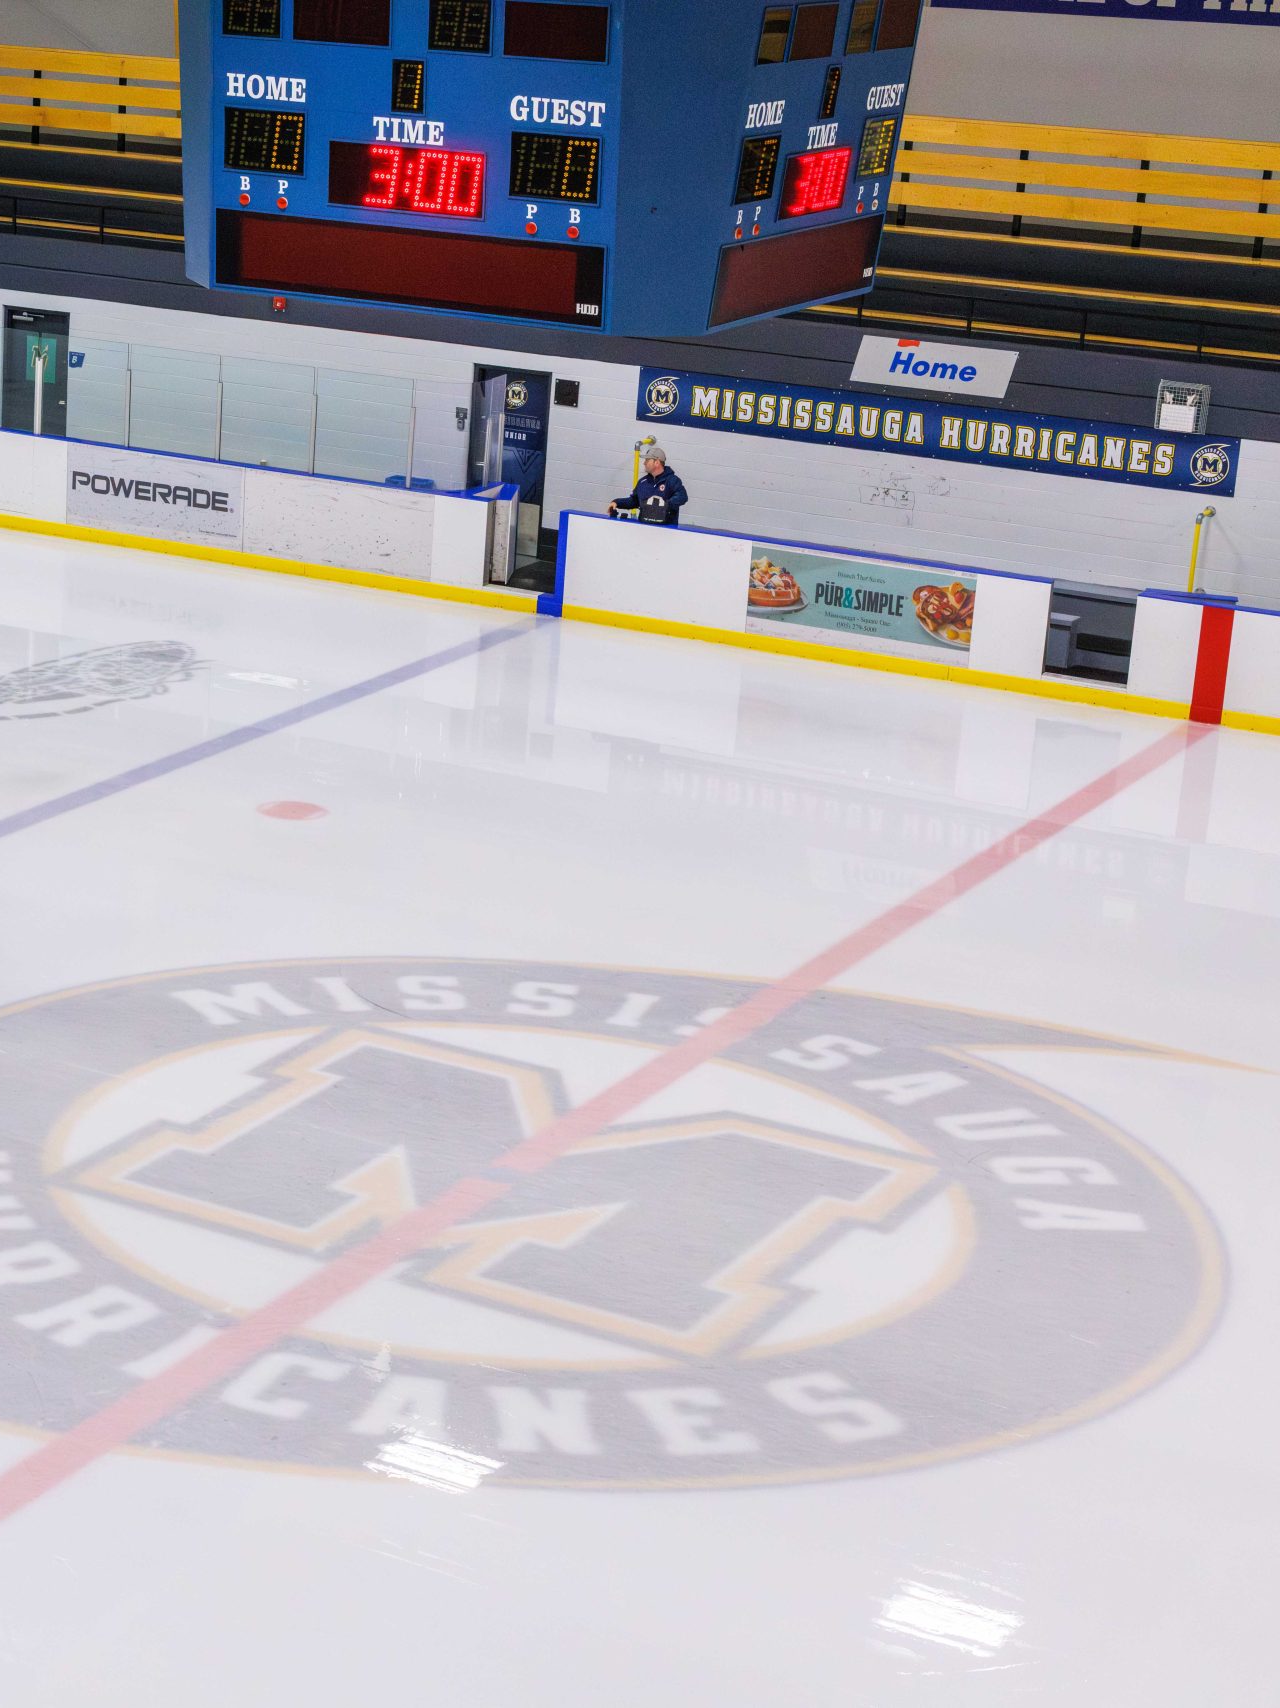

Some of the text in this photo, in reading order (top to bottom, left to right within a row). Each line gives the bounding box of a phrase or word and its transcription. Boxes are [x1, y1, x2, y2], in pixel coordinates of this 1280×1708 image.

[226, 72, 307, 103] HOME
[867, 83, 904, 110] GUEST
[510, 94, 606, 128] GUEST
[745, 100, 785, 129] HOME
[373, 116, 445, 146] TIME
[807, 123, 838, 150] TIME
[240, 175, 251, 191] B
[277, 180, 288, 194] P
[363, 146, 484, 214] 3:00
[786, 150, 851, 216] 3:00
[857, 186, 864, 200] P
[872, 183, 879, 197] B
[525, 204, 538, 219] P
[569, 208, 581, 224] B
[736, 209, 744, 225] B
[754, 206, 761, 221] P
[888, 351, 977, 383] Home
[654, 388, 671, 404] M
[690, 385, 1176, 478] MISSISSAUGA HURRICANES
[1200, 456, 1220, 474] M
[72, 470, 230, 513] POWERADE
